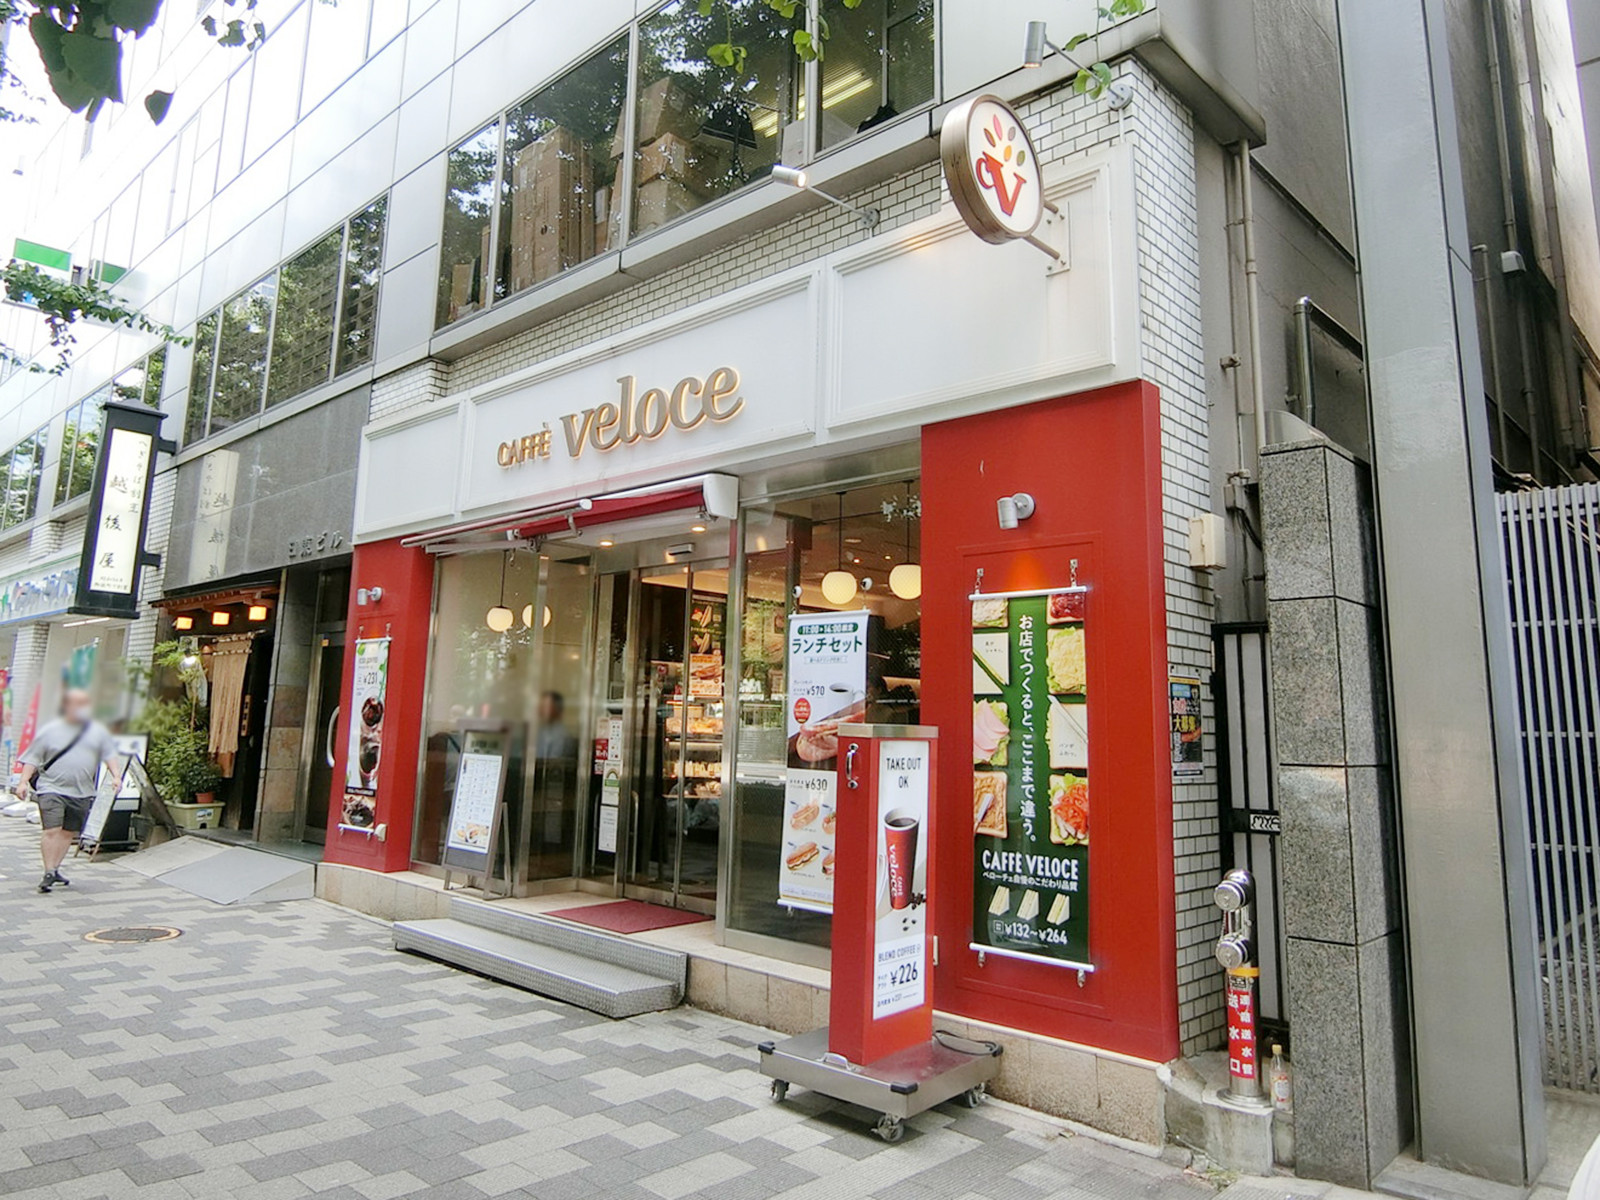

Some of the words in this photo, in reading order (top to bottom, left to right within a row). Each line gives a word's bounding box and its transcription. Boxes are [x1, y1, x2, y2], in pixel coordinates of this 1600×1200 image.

[497, 422, 552, 468] CAFFÈ
[560, 366, 745, 459] veloce
[99, 474, 129, 570] 越後屋
[792, 635, 863, 654] ランチセット
[806, 685, 825, 696] ¥570
[1018, 614, 1037, 842] お店でつくると、ここまで違う。
[886, 757, 905, 771] TAKE
[906, 757, 922, 770] OUT
[804, 778, 828, 792] ¥630
[898, 776, 909, 788] OK
[888, 843, 898, 897] veloce
[1025, 853, 1079, 881] VELOCE
[878, 949, 896, 963] BLEND
[897, 944, 916, 959] COFFEE
[890, 961, 918, 987] ¥226
